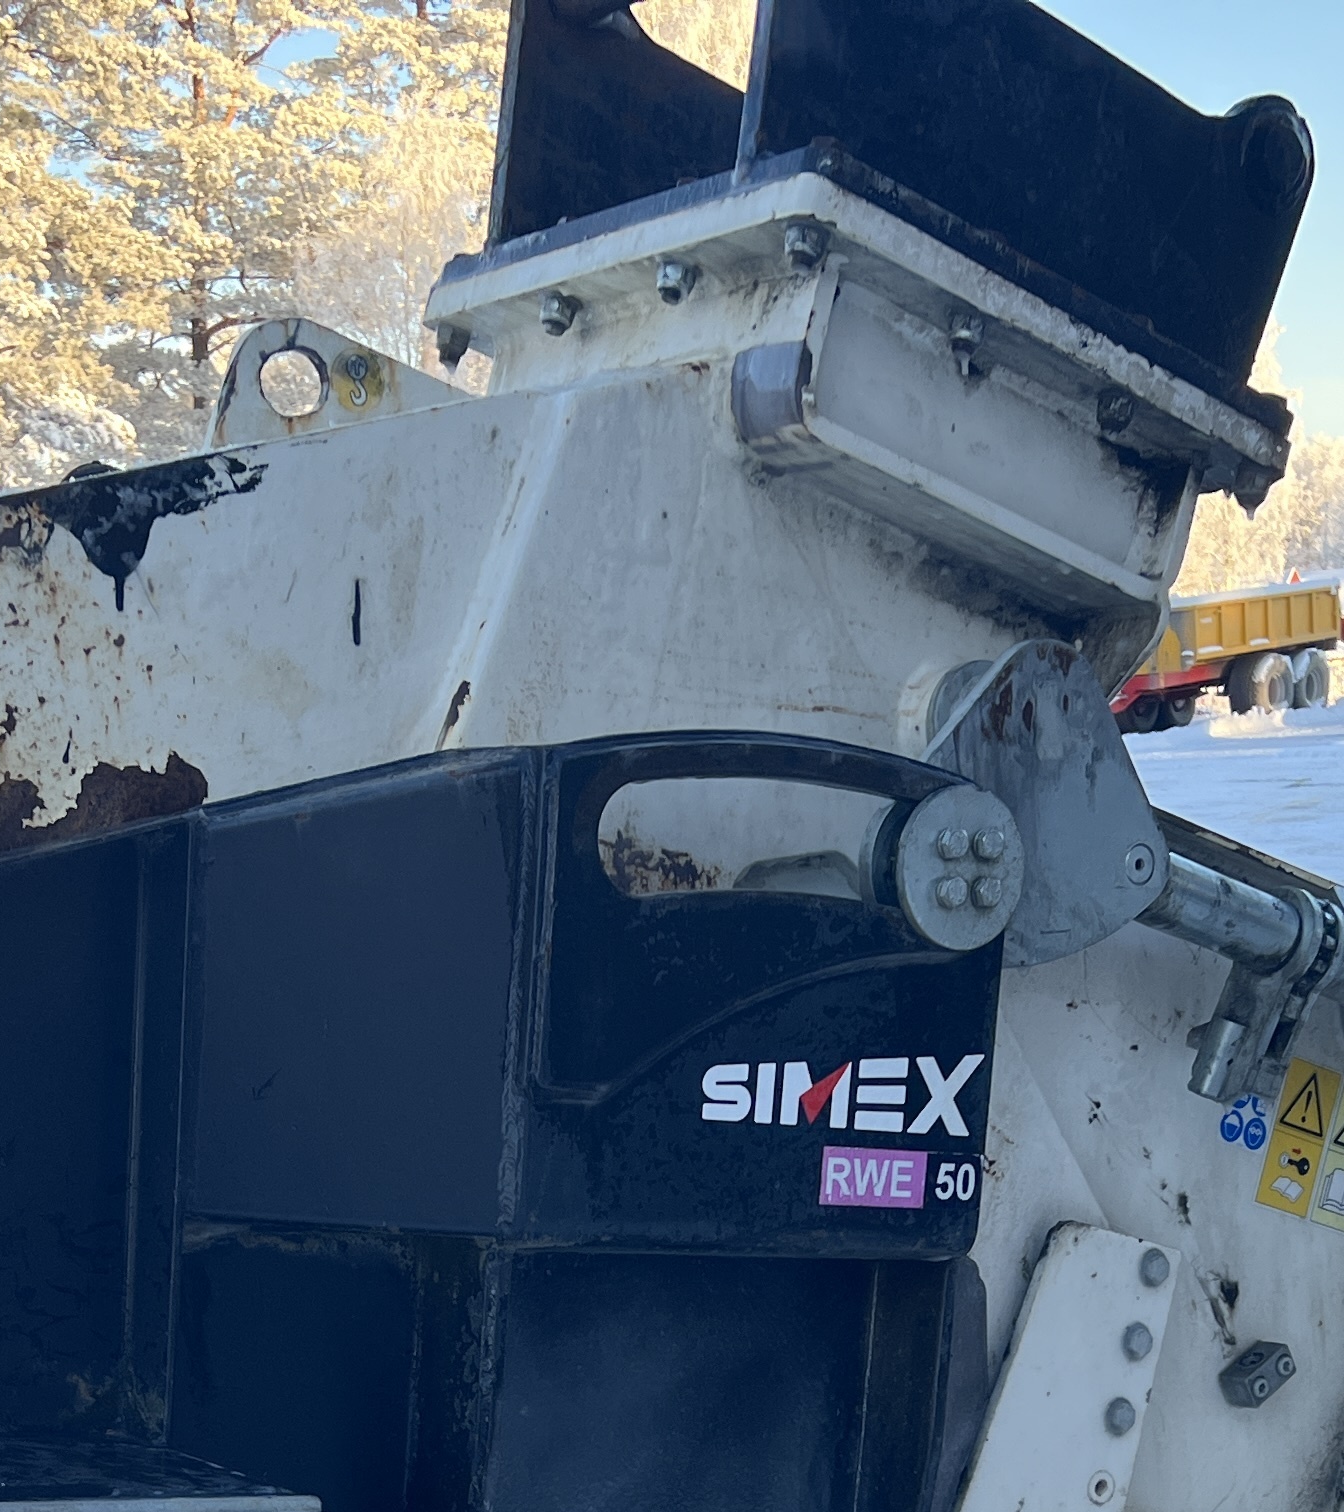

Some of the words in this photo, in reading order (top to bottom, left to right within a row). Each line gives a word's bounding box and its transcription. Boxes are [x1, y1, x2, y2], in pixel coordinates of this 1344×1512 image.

[701, 1053, 986, 1137] SIMEX
[824, 1156, 915, 1199] RWE
[934, 1162, 976, 1201] 50
